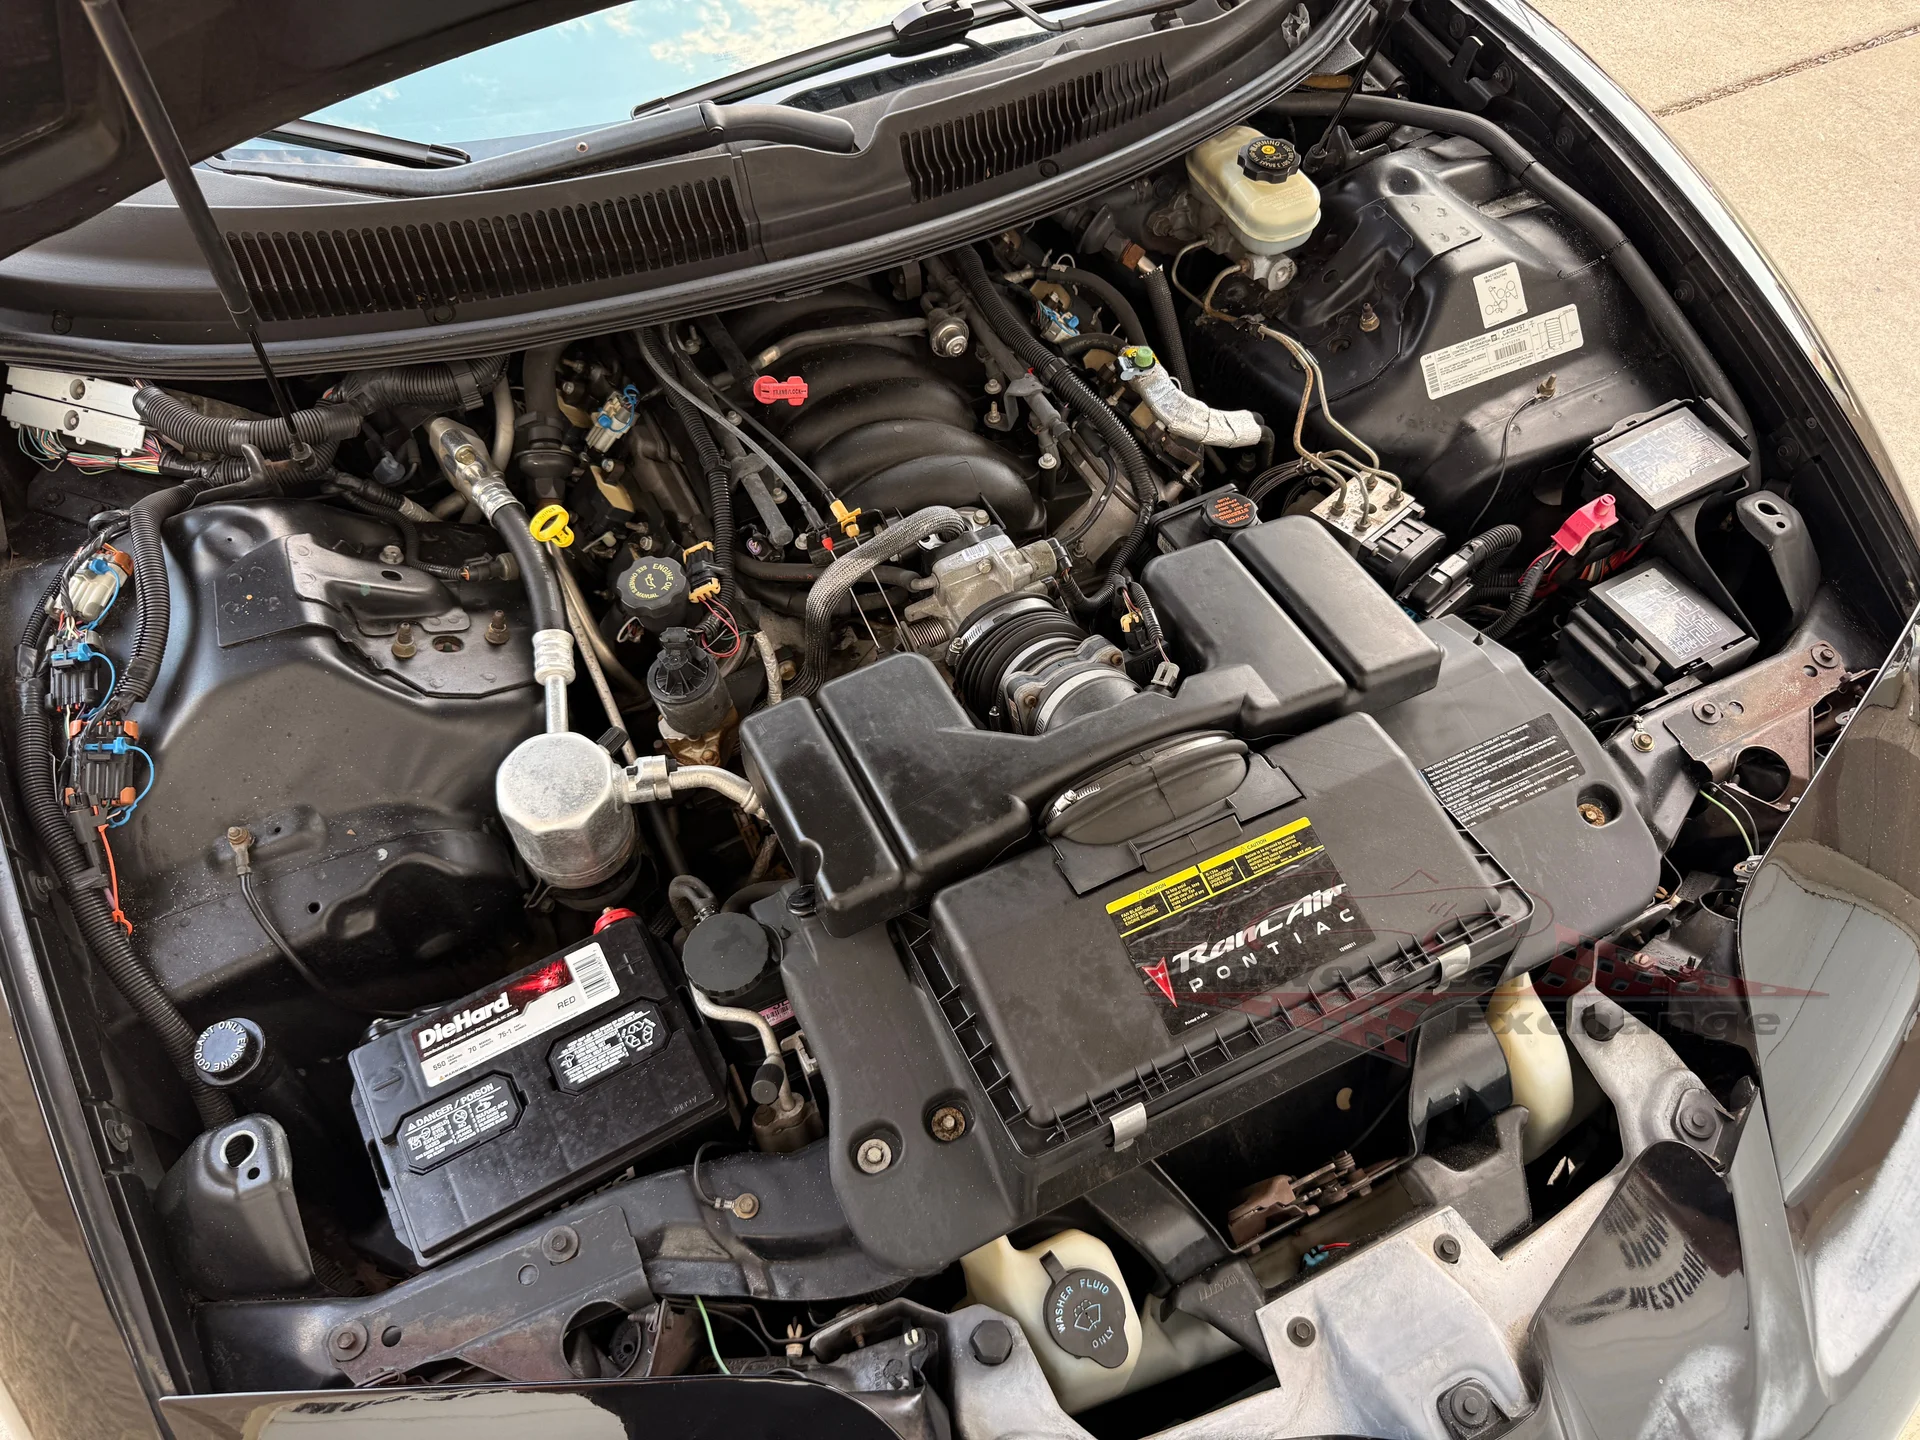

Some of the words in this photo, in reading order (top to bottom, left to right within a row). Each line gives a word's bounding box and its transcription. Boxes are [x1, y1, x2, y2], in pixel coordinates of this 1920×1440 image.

[1249, 140, 1280, 151] WARNING
[1501, 323, 1526, 335] CATALYST
[1218, 507, 1249, 520] STEERING
[1226, 513, 1249, 524] POWER
[652, 563, 674, 581] ENGINE
[661, 581, 672, 591] OIL
[1246, 837, 1267, 850] CAUTION
[1145, 881, 1167, 895] CAUTION
[1121, 911, 1138, 922] STARTS
[1137, 903, 1156, 915] WITHOUT
[1128, 905, 1143, 914] BLADE
[1172, 918, 1283, 973] Ram
[1286, 883, 1347, 925] Air
[1188, 908, 1355, 993] PONTIAC
[557, 995, 576, 1011] RED
[419, 993, 510, 1047] DieHard
[218, 1021, 245, 1035] ONLY
[194, 1025, 214, 1069] COOLANT
[213, 1037, 245, 1070] ENGINE
[467, 1044, 477, 1054] 70
[431, 1059, 447, 1071] 550
[414, 1102, 454, 1127] DANGER
[459, 1082, 494, 1105] POISON
[457, 1120, 467, 1129] NO
[1055, 1285, 1074, 1334] WASHER
[1079, 1278, 1109, 1294] FLUID
[1092, 1326, 1114, 1348] ONLY
